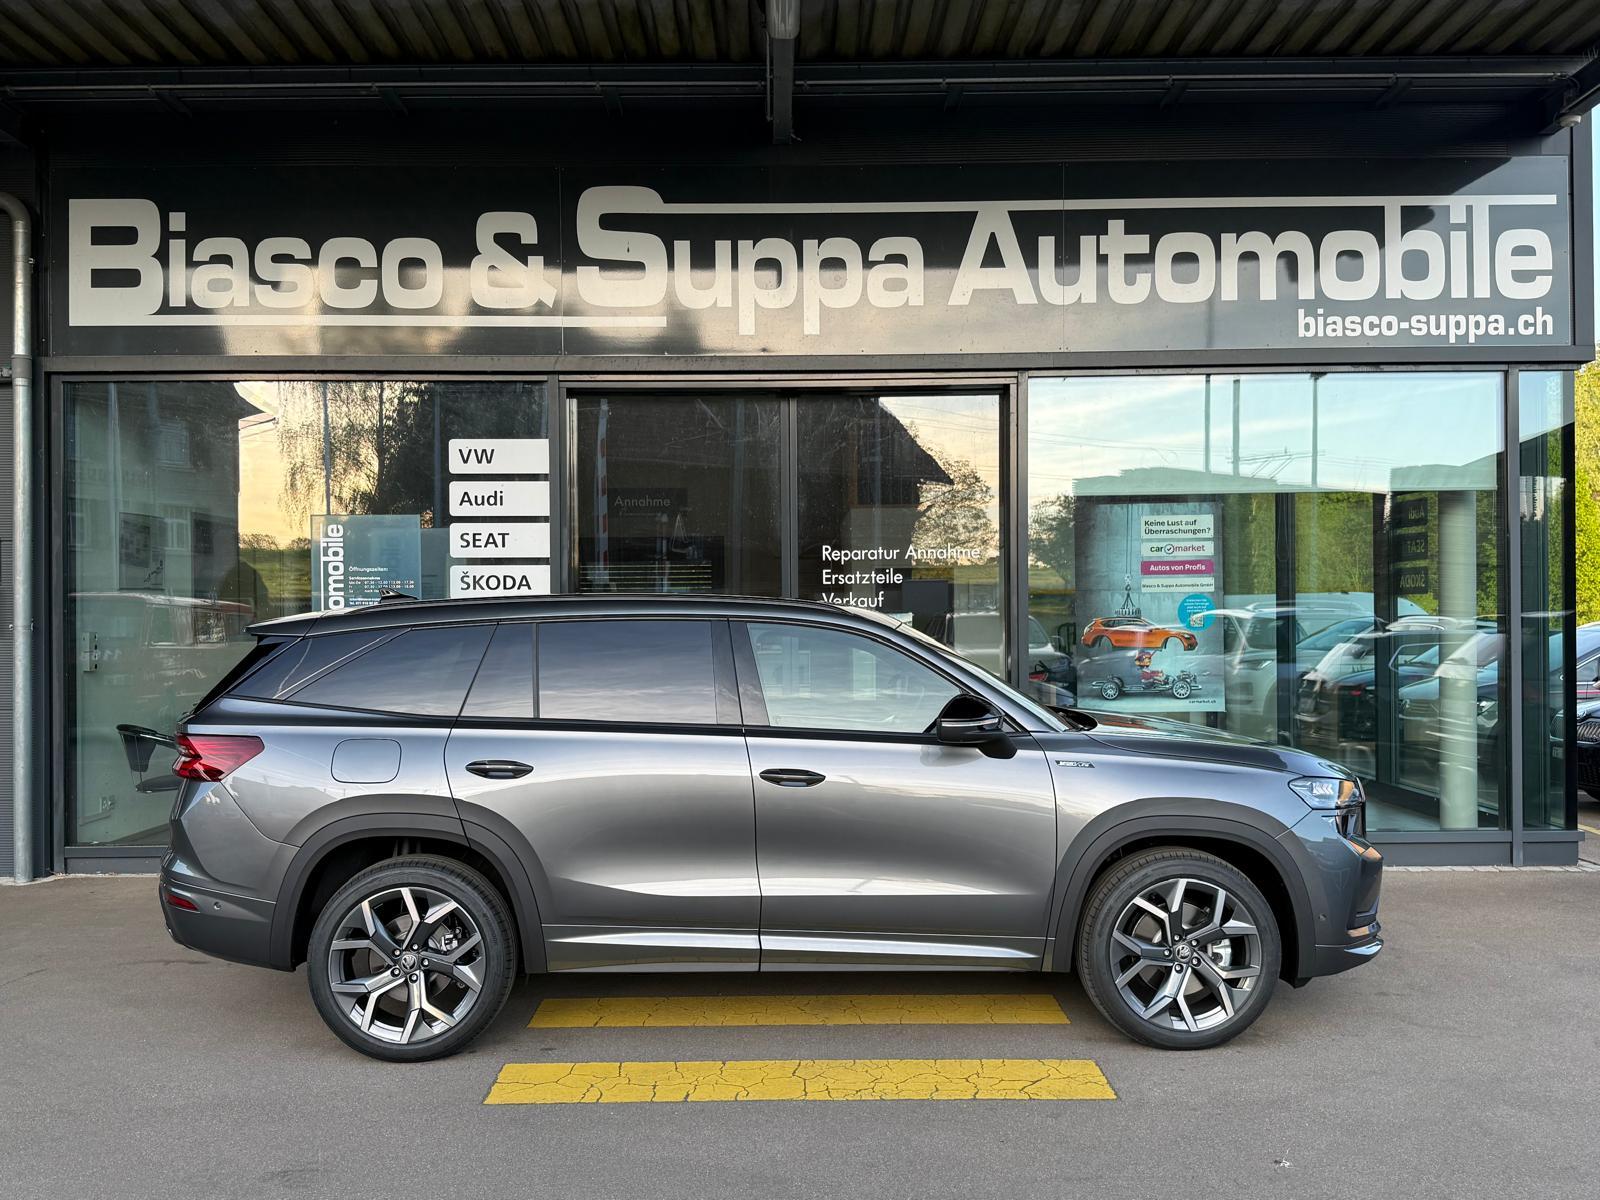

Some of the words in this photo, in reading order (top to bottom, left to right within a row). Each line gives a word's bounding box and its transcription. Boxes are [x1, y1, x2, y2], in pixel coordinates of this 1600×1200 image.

[69, 199, 444, 326] Biasco
[470, 211, 557, 309] &
[576, 186, 924, 336] Suppa
[948, 196, 1555, 307] Automobile
[1298, 307, 1554, 343] biasco-suppa.ch
[458, 448, 495, 464] VW
[459, 490, 504, 507] Audi
[614, 495, 671, 507] Annahme
[1144, 527, 1211, 535] Überraschungen?
[460, 532, 510, 548] SEAT
[822, 545, 900, 565] Reparatur
[904, 544, 981, 560] Annahme
[460, 571, 532, 591] ŠKODA
[822, 568, 903, 585] Ersatzteile
